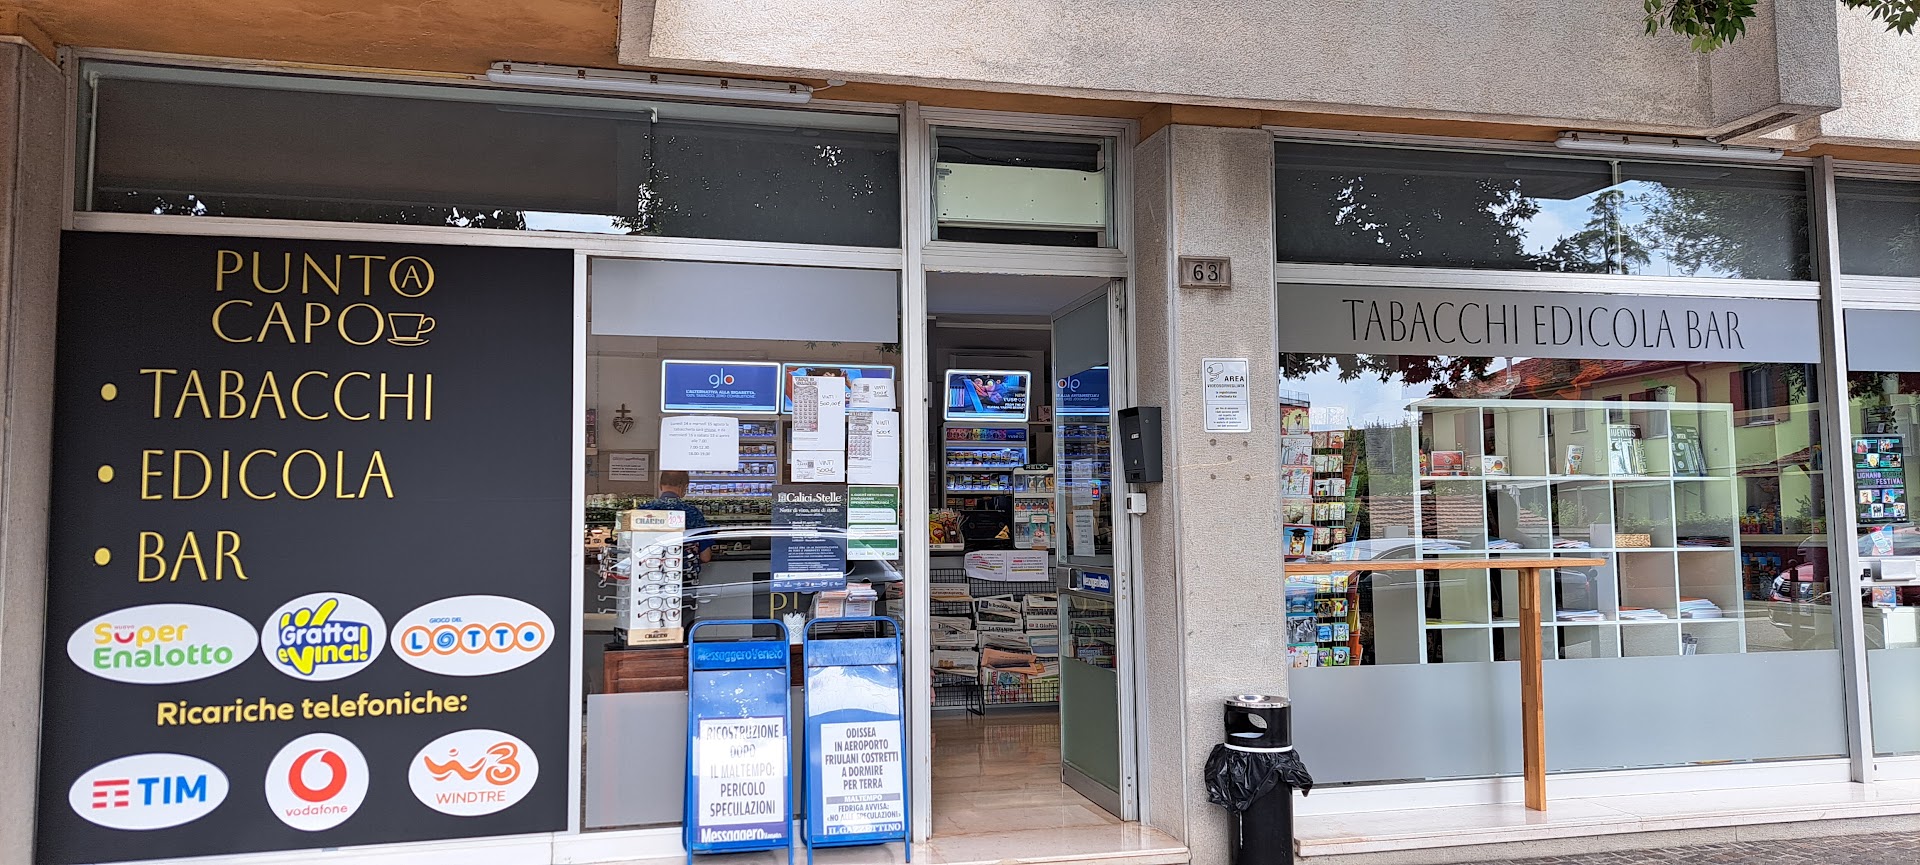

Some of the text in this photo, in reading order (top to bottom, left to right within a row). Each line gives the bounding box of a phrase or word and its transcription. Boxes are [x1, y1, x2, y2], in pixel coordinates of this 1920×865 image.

[215, 249, 435, 298] PUNTO
[1193, 264, 1219, 282] 63
[211, 299, 385, 346] CAPO
[1342, 299, 1746, 350] TABACCHI EDICOLA BAR
[708, 367, 735, 389] glo
[139, 368, 433, 421] TABACCHI
[140, 449, 396, 501] EDICOLA
[786, 491, 812, 503] Calici
[816, 491, 842, 503] Stelle
[137, 530, 249, 583] BAR
[429, 617, 463, 628] GIOCO DEL
[93, 622, 189, 649] Super
[284, 625, 360, 648] Gratta
[92, 643, 234, 670] Enalotto
[156, 690, 469, 727] Ricariche telefoniche:
[706, 724, 780, 741] RICOSTRUZIONE
[846, 727, 877, 739] ODISSEA
[834, 739, 889, 753] IN AEROPORTO
[825, 751, 899, 766] FRIULANI COSTRETTI
[710, 762, 776, 779] IL MALTEMPO:
[841, 765, 884, 778] A DORMIRE
[136, 774, 207, 806] TIM
[720, 781, 766, 798] PERICOLO
[843, 777, 884, 791] PER TERRA
[435, 789, 507, 805] WINDTRE
[844, 794, 883, 803] MALTEMPO
[285, 802, 349, 819] vodafone
[710, 800, 776, 817] SPECULAZIONI
[838, 802, 890, 814] FEDRIGA AVVISA:
[828, 826, 839, 835] IL
